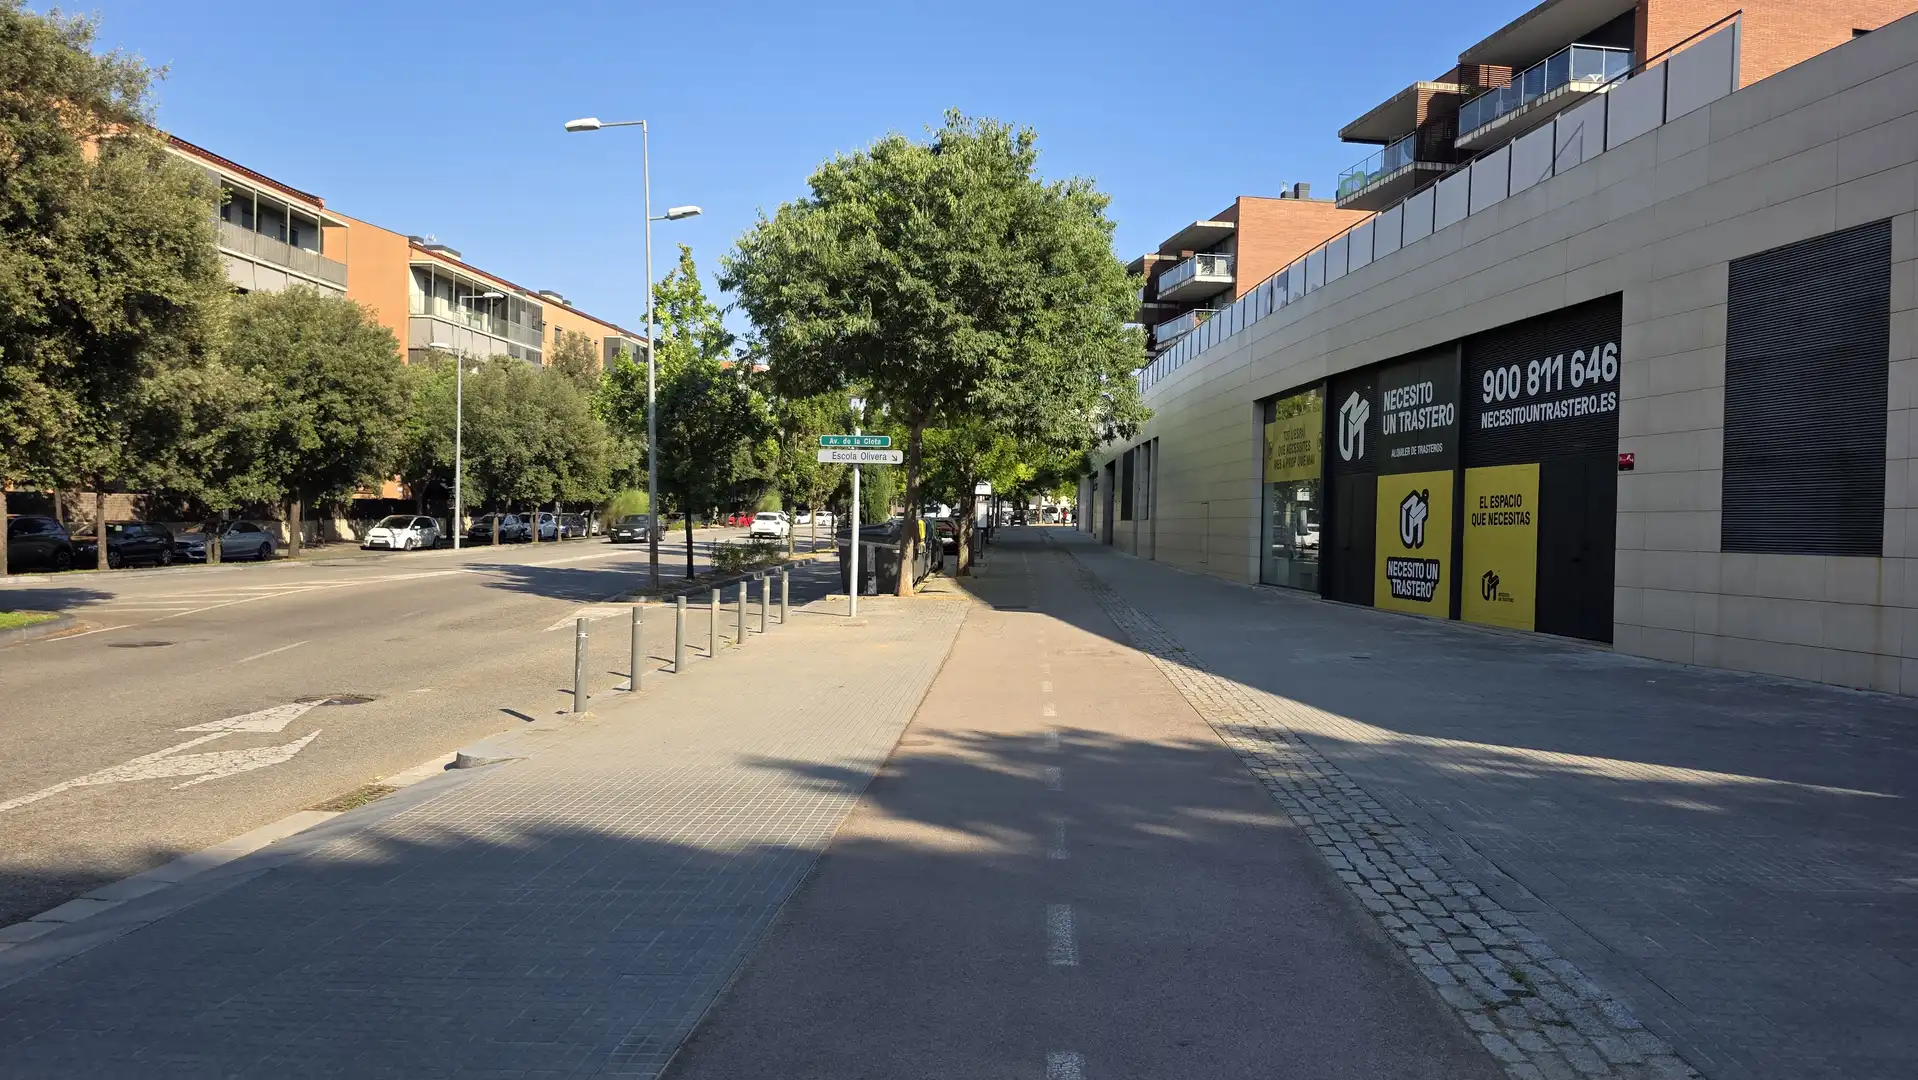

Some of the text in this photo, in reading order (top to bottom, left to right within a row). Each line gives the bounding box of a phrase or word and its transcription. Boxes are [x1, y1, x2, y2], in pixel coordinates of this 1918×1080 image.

[1482, 342, 1618, 404] 900 811 646
[1383, 381, 1433, 412] NECESITO
[1383, 402, 1455, 436] UN TRASTERO
[1481, 391, 1617, 429] NECESITOUNTRASTERO.ES
[829, 437, 840, 445] Av.
[842, 437, 851, 445] de
[854, 437, 861, 445] la
[1391, 442, 1444, 458] ALQUILER DE TRASTEROS
[832, 451, 887, 461] Escola Olivera
[1480, 493, 1522, 509] EL ESPACIO
[1471, 511, 1531, 527] QUE NECESITAS
[1387, 560, 1438, 580] NECESITO UN
